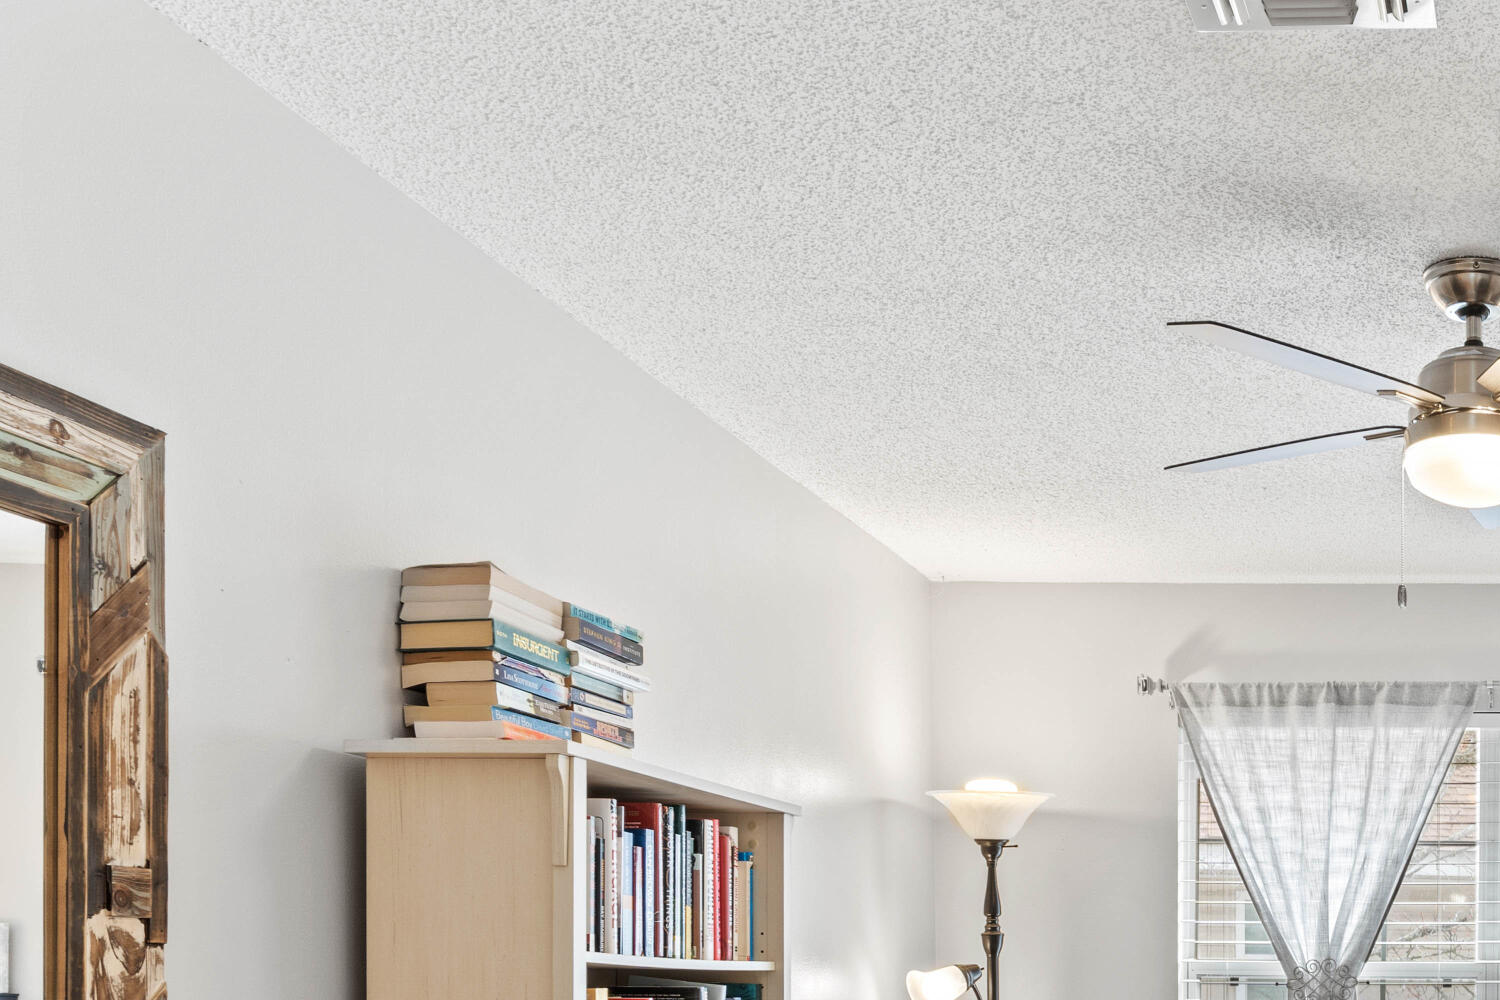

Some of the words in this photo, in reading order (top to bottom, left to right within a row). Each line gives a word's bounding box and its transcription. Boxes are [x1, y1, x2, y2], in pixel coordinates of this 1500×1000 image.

[579, 609, 595, 622] STARTS
[595, 615, 606, 626] WITH
[583, 626, 604, 641] STEPHEN
[512, 632, 560, 663] INSURGENT
